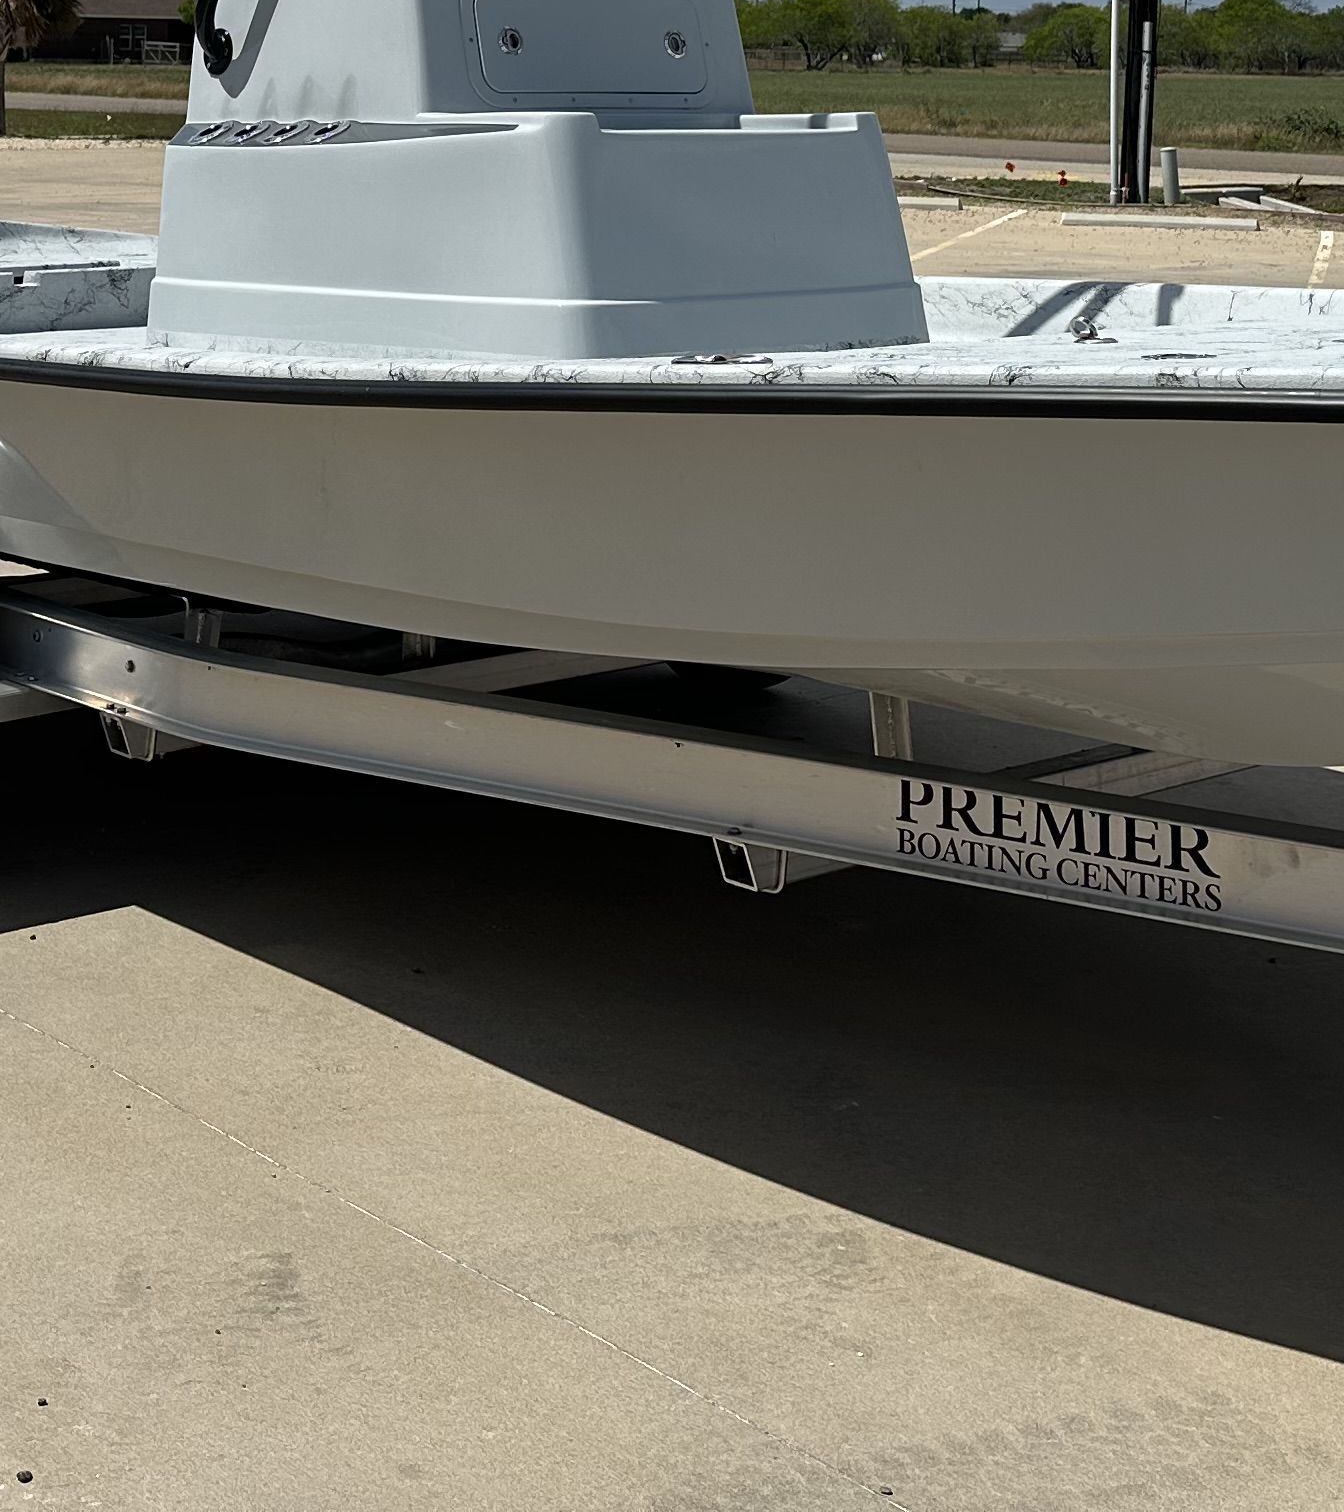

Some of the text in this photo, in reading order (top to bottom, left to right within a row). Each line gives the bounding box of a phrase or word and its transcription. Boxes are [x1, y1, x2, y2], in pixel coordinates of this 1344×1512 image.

[895, 779, 1221, 879] PREMIER
[895, 828, 1222, 912] BOATING CENTERS
